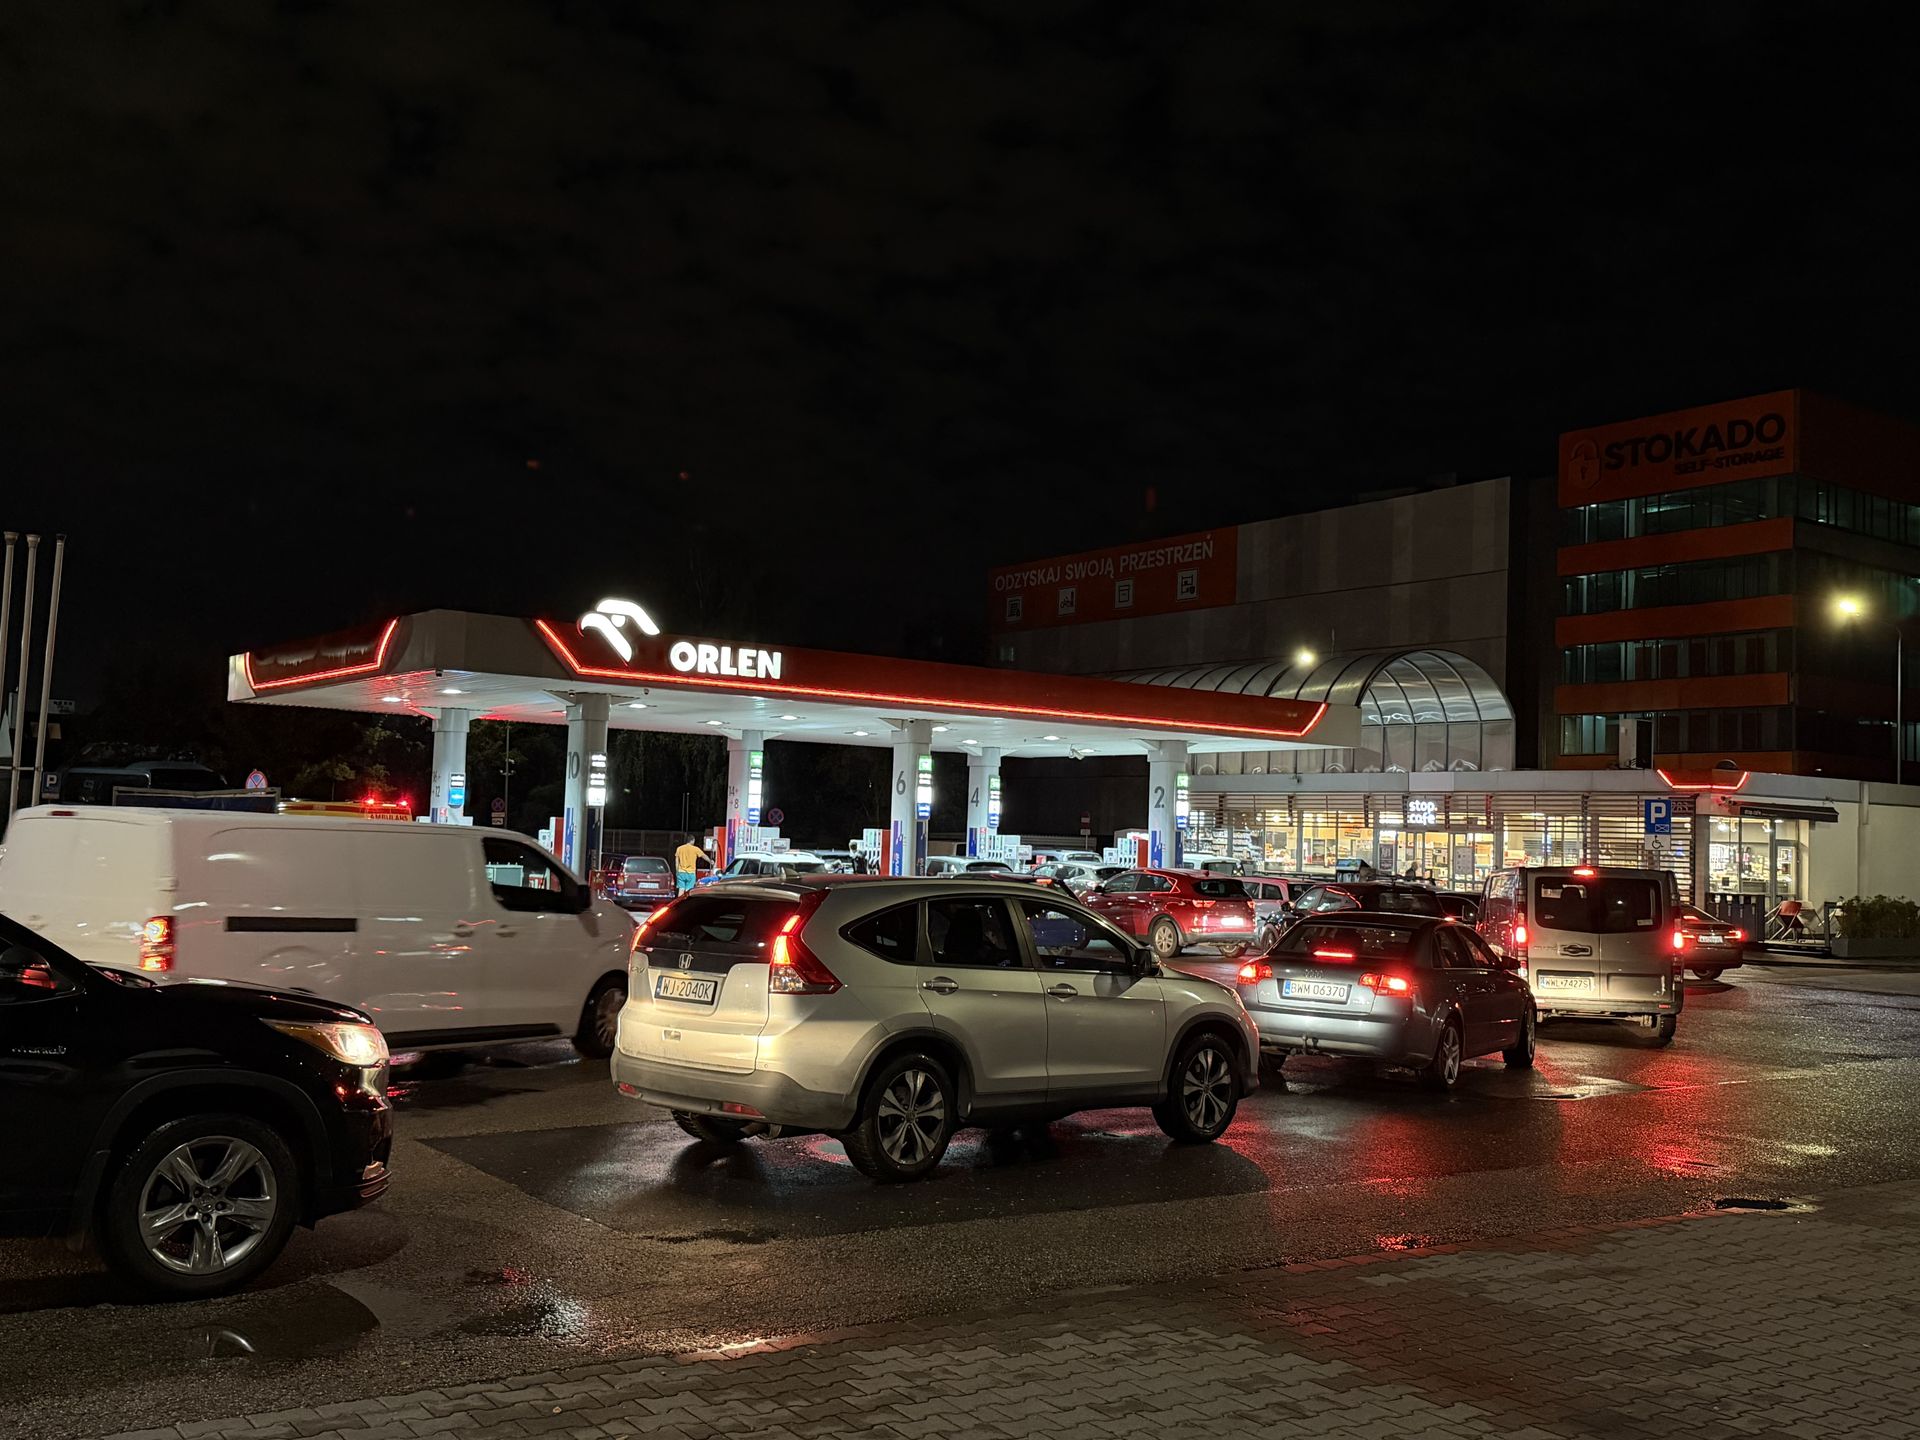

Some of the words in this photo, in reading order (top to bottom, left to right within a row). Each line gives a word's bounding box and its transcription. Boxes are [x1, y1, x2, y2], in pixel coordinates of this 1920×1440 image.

[1605, 413, 1786, 470] STOKADO
[994, 568, 1061, 592] ODZYSKAJ
[1064, 557, 1115, 578] SWOJĄ
[1120, 534, 1214, 572] PRZESTRZEŃ
[670, 641, 782, 680] ORLEN
[568, 752, 580, 780] 10
[46, 775, 58, 788] P
[896, 770, 906, 795] 6
[970, 787, 979, 807] 4
[1409, 812, 1436, 825] cafe
[1650, 802, 1666, 824] P
[1312, 983, 1346, 998] 06370
